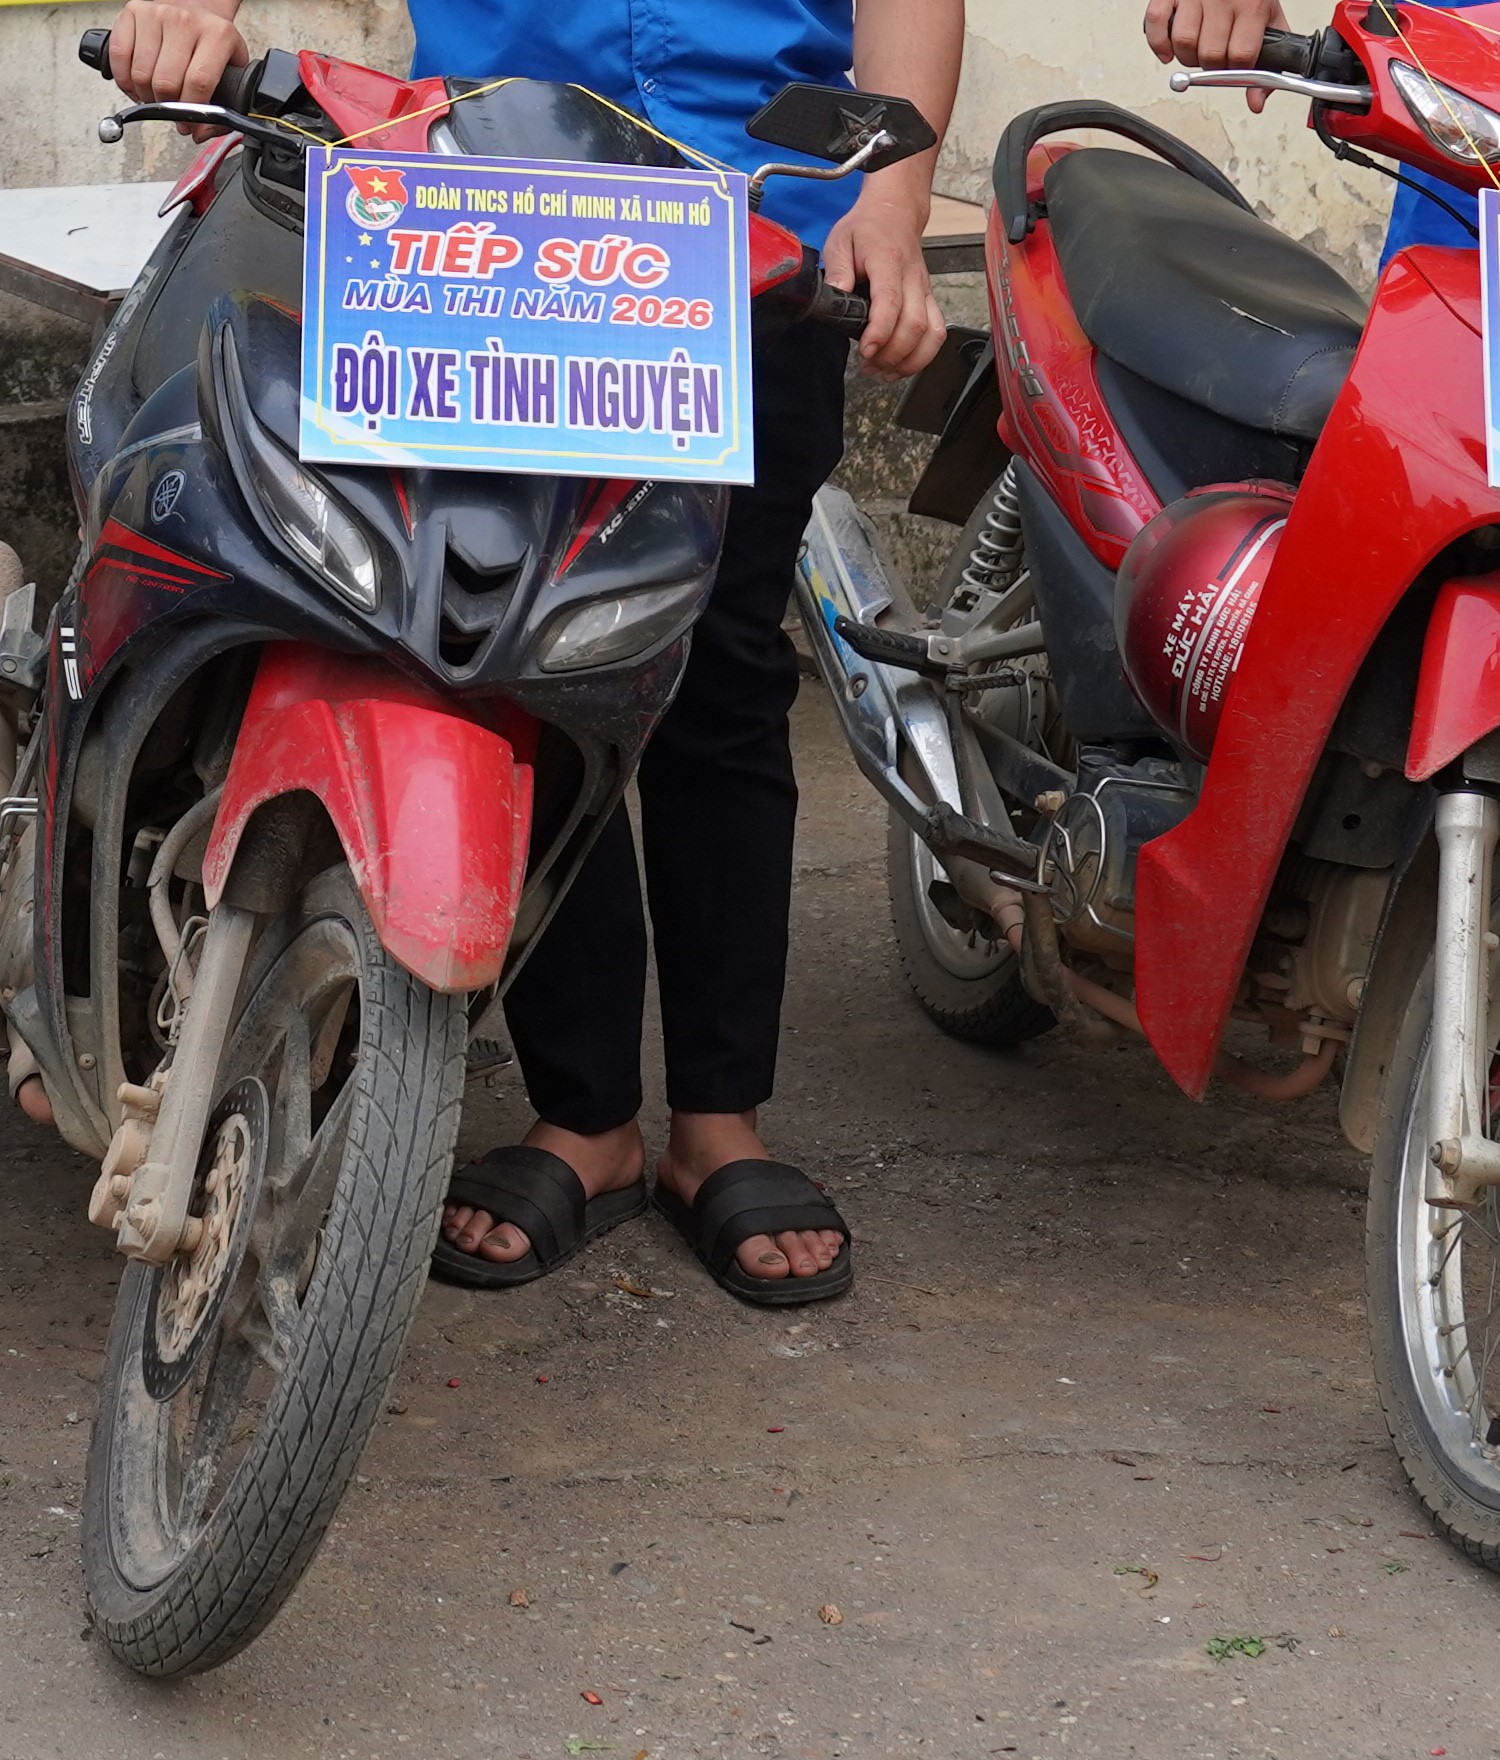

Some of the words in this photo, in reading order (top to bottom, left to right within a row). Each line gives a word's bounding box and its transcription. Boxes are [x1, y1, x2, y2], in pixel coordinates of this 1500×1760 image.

[332, 330, 401, 433] ĐỘI
[406, 348, 460, 423] XE
[468, 337, 559, 428] TÌNH
[565, 348, 722, 451] NGUYỆN
[1162, 633, 1177, 657] XE
[1171, 589, 1195, 631] MÁY
[1171, 627, 1197, 678] ĐỨC
[1191, 583, 1219, 626] HẢI
[1210, 653, 1233, 701] HOTLINE:
